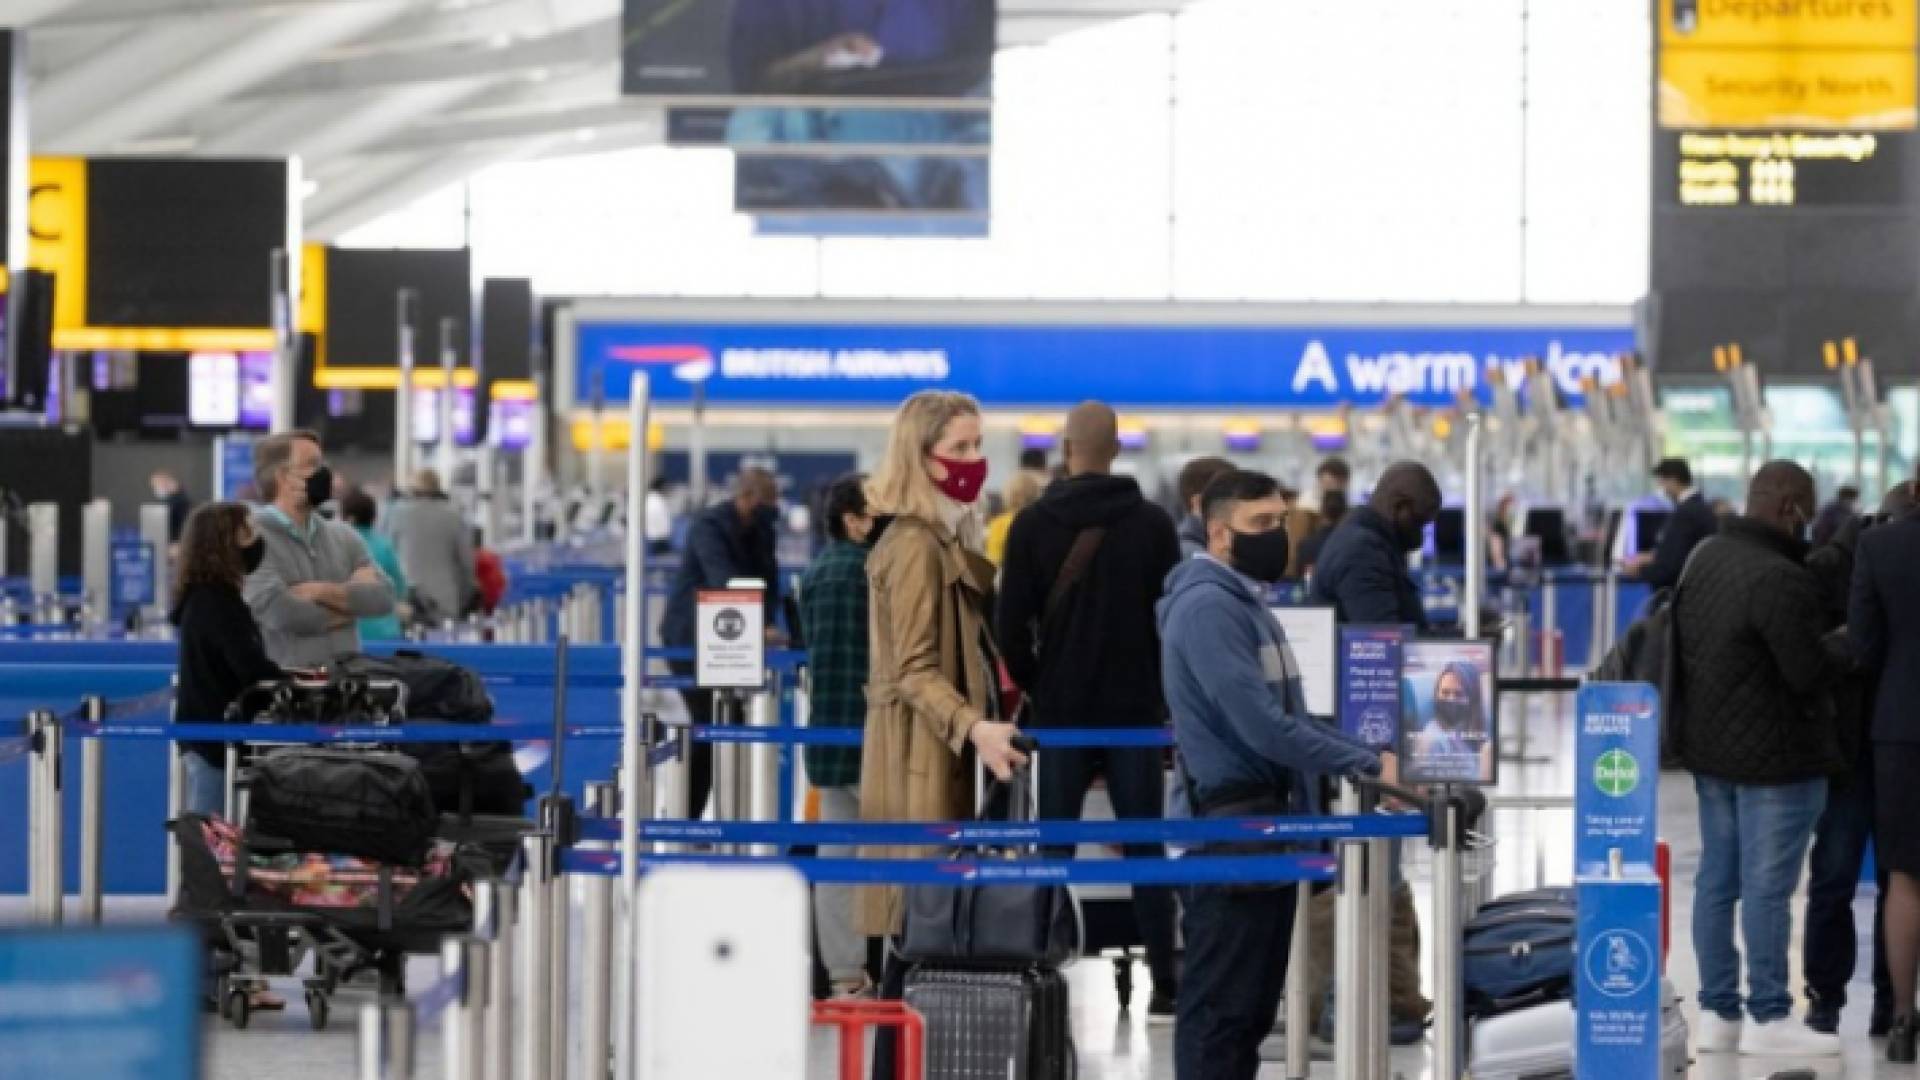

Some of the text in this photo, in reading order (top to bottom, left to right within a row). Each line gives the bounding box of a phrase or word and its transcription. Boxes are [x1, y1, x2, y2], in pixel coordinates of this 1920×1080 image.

[1705, 0, 1895, 24] Departures
[1705, 75, 1894, 100] Security North
[721, 348, 948, 379] BRITISH AIRWAYS
[1292, 340, 1338, 392] A
[1347, 352, 1476, 393] warm
